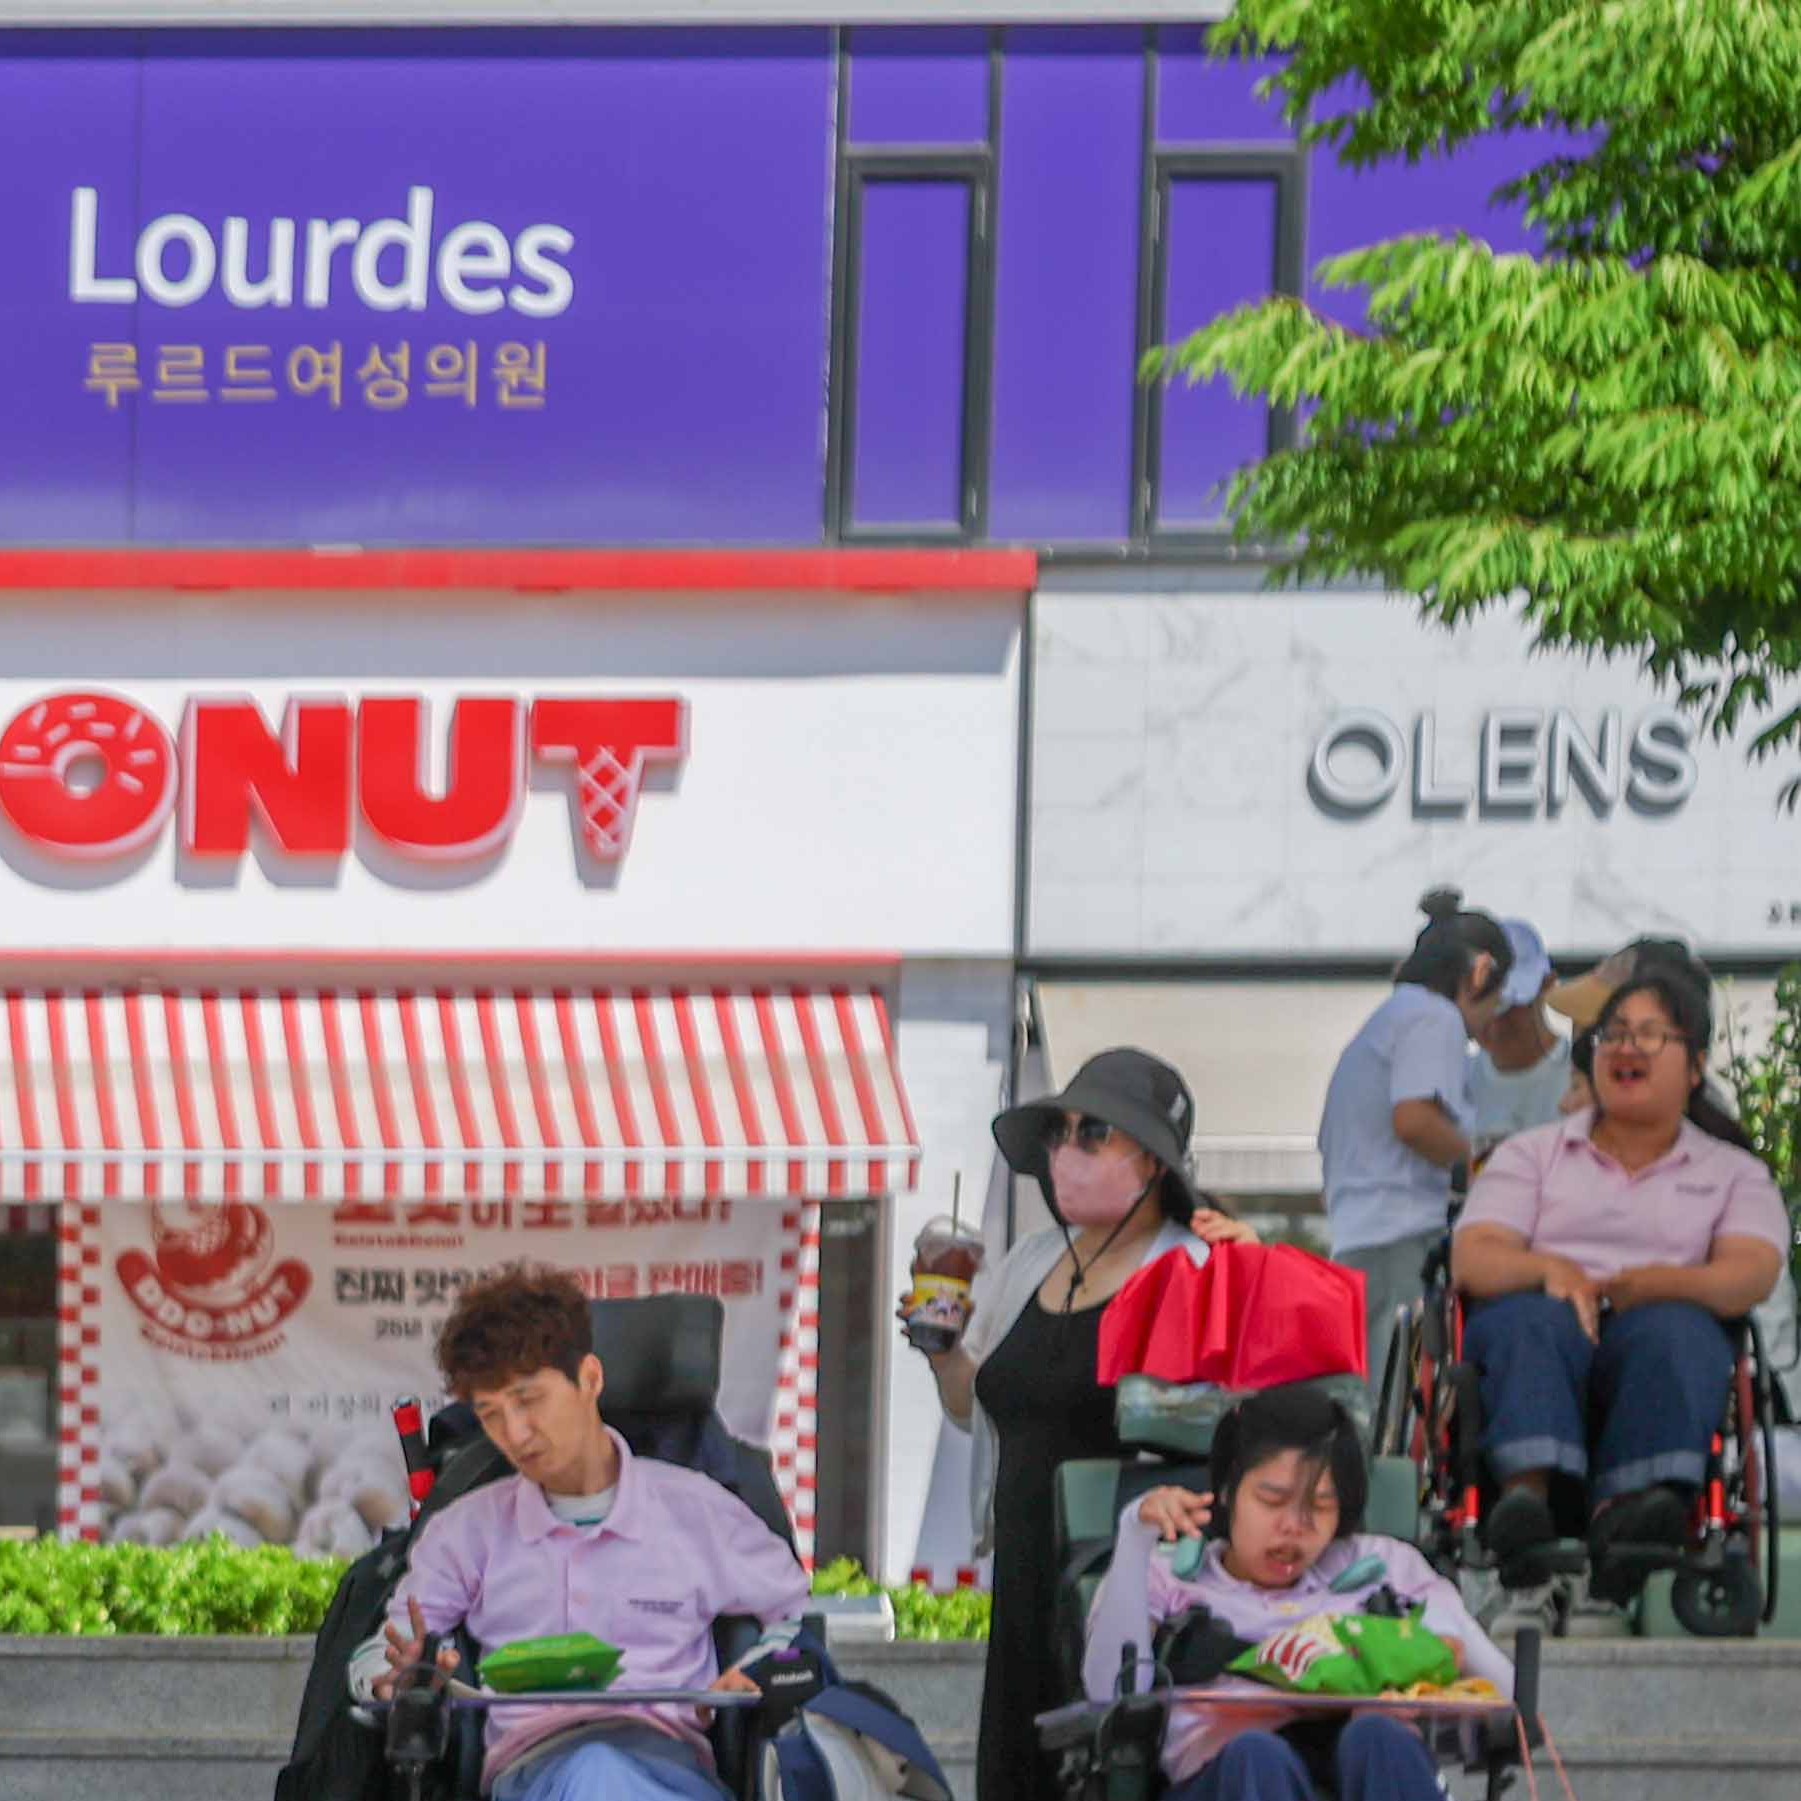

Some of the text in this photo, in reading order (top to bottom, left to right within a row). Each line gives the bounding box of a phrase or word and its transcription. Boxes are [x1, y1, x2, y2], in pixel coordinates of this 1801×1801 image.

[66, 187, 576, 318] Lourdes
[83, 340, 550, 408] 루르드여성의원
[1308, 706, 1700, 820] OLENS
